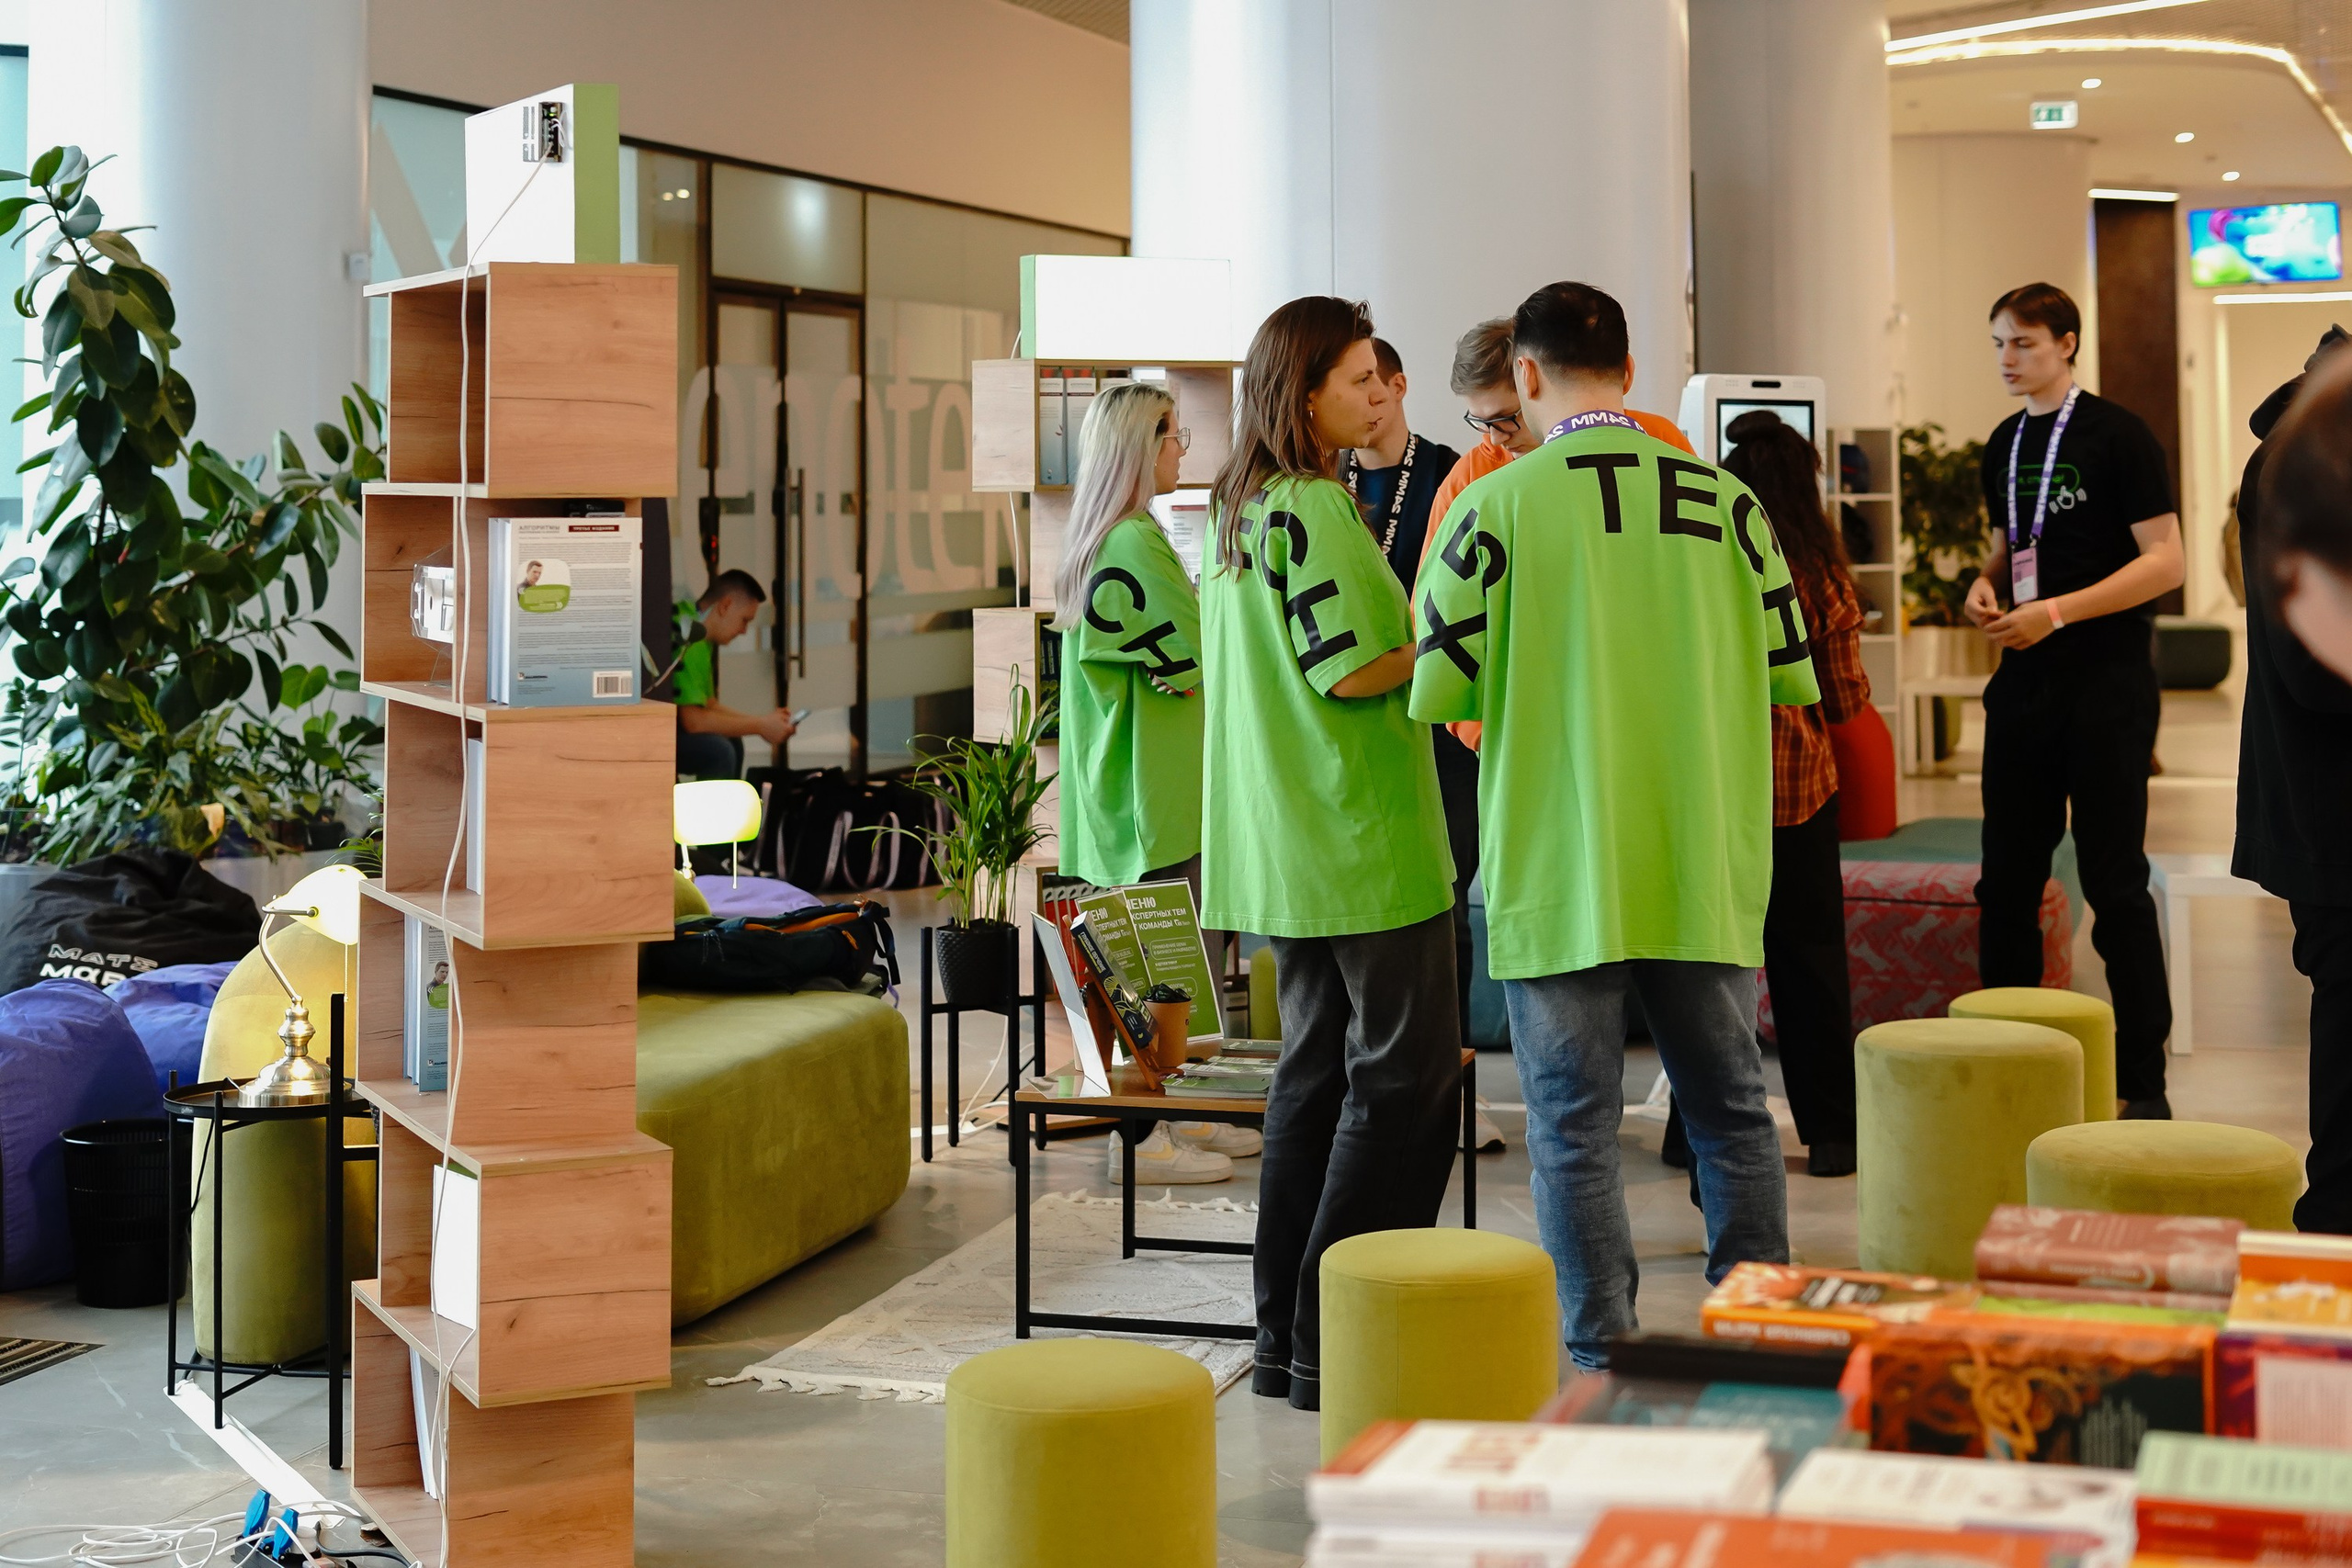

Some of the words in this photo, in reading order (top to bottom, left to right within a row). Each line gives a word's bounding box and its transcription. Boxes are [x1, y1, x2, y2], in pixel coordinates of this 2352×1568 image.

[1570, 412, 1631, 429] MMAS
[1391, 470, 1410, 514] MMAS
[1216, 490, 1358, 675] ECH
[1416, 508, 1507, 683] X5
[1566, 453, 1810, 668] TECH
[1083, 567, 1198, 677] CH
[1132, 909, 1172, 920] КСПЕРТНЫХ
[1173, 908, 1187, 916] ТЕМ
[1139, 920, 1173, 931] КОМАНДЫ
